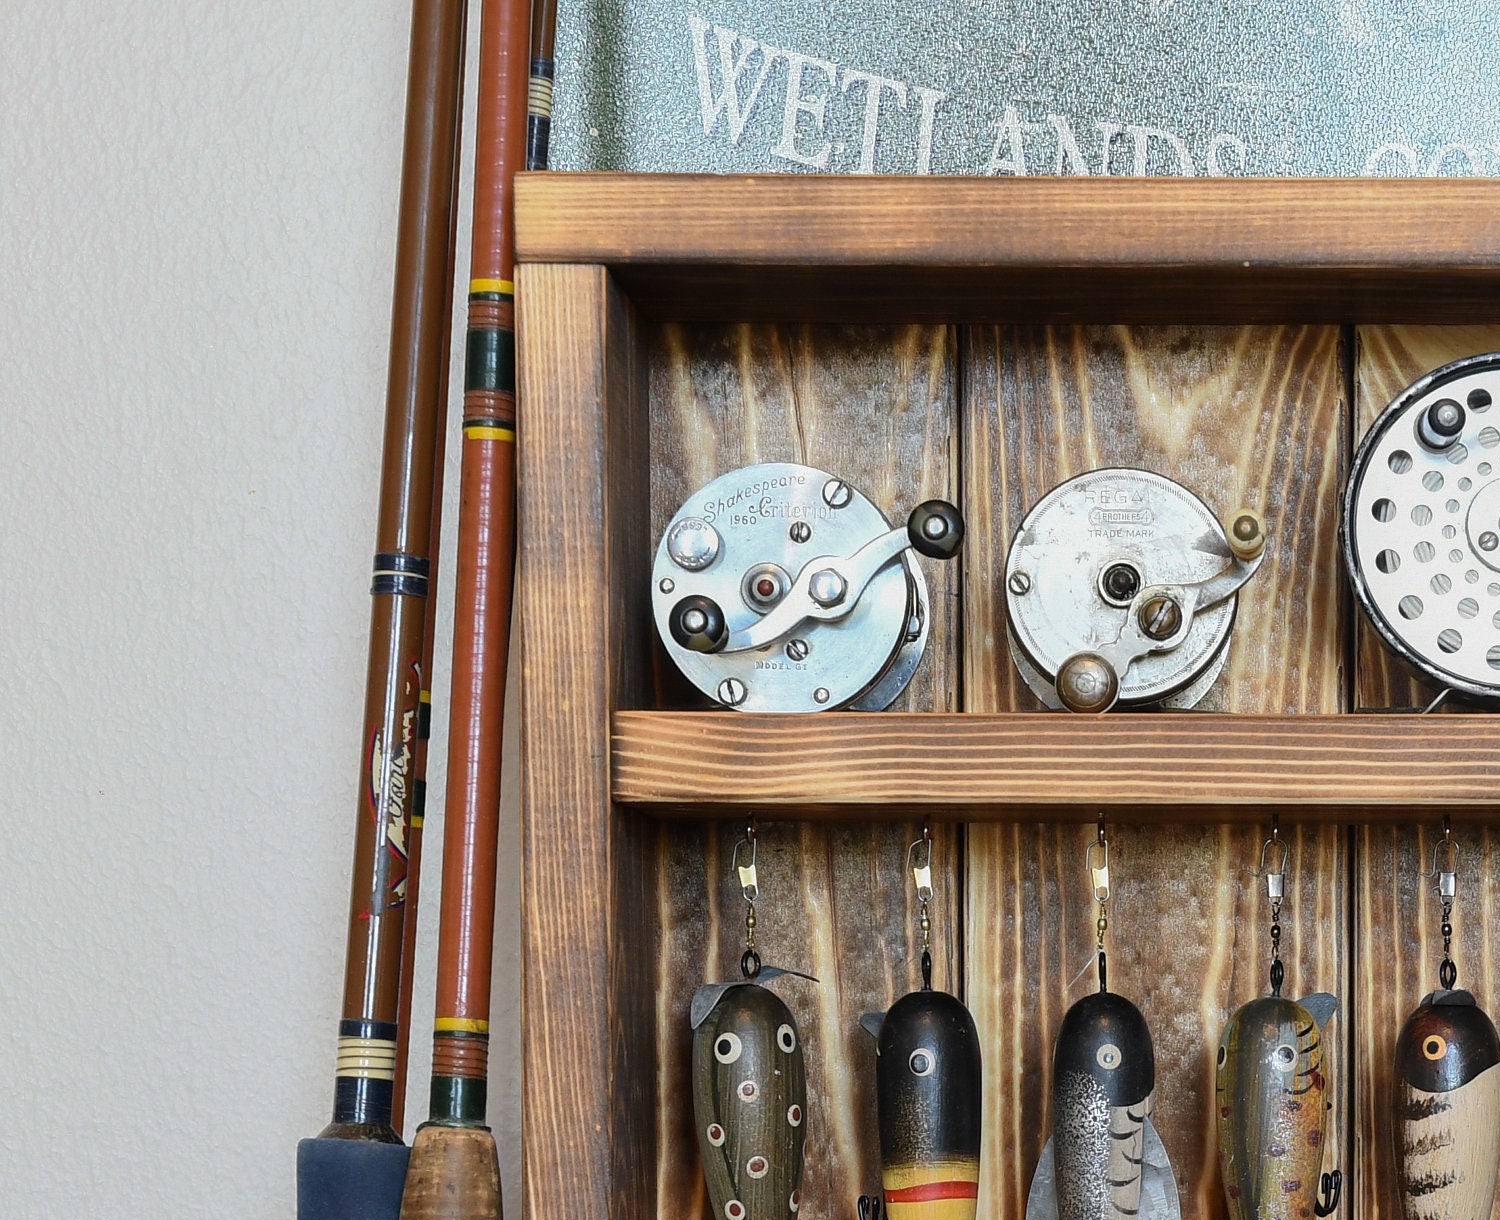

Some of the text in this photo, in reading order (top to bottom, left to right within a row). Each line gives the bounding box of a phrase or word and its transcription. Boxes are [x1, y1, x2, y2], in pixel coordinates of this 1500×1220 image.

[703, 474, 806, 523] Shakespeare
[748, 496, 838, 519] Criterion
[729, 514, 757, 526] 1960
[1087, 529, 1155, 538] TRADE MARK
[753, 660, 791, 670] MODEL
